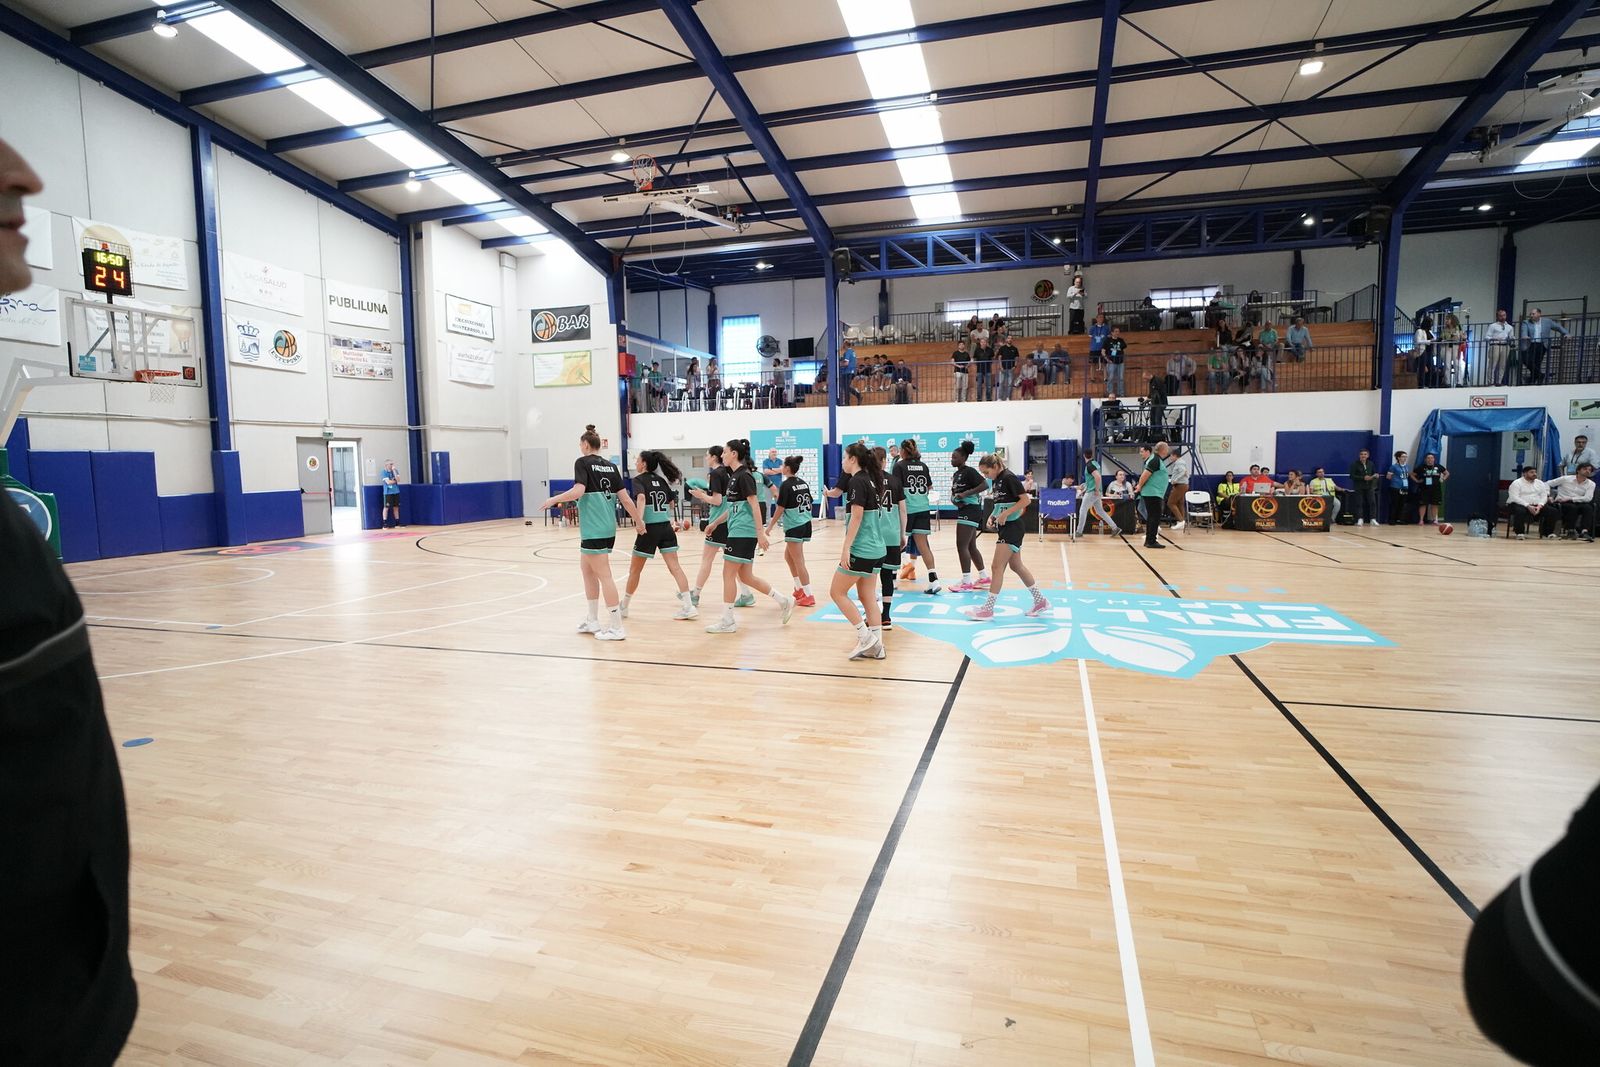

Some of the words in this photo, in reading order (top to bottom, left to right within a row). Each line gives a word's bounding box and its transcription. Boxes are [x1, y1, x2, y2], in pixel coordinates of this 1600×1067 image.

[95, 252, 123, 267] 16:50
[95, 266, 125, 288] 24
[329, 294, 388, 315] PUBLILUNA
[557, 313, 589, 333] BAR
[907, 475, 928, 497] 33
[650, 490, 667, 513] 12
[796, 492, 812, 514] 23
[1047, 499, 1070, 507] molten
[1097, 607, 1351, 630] FINAL
